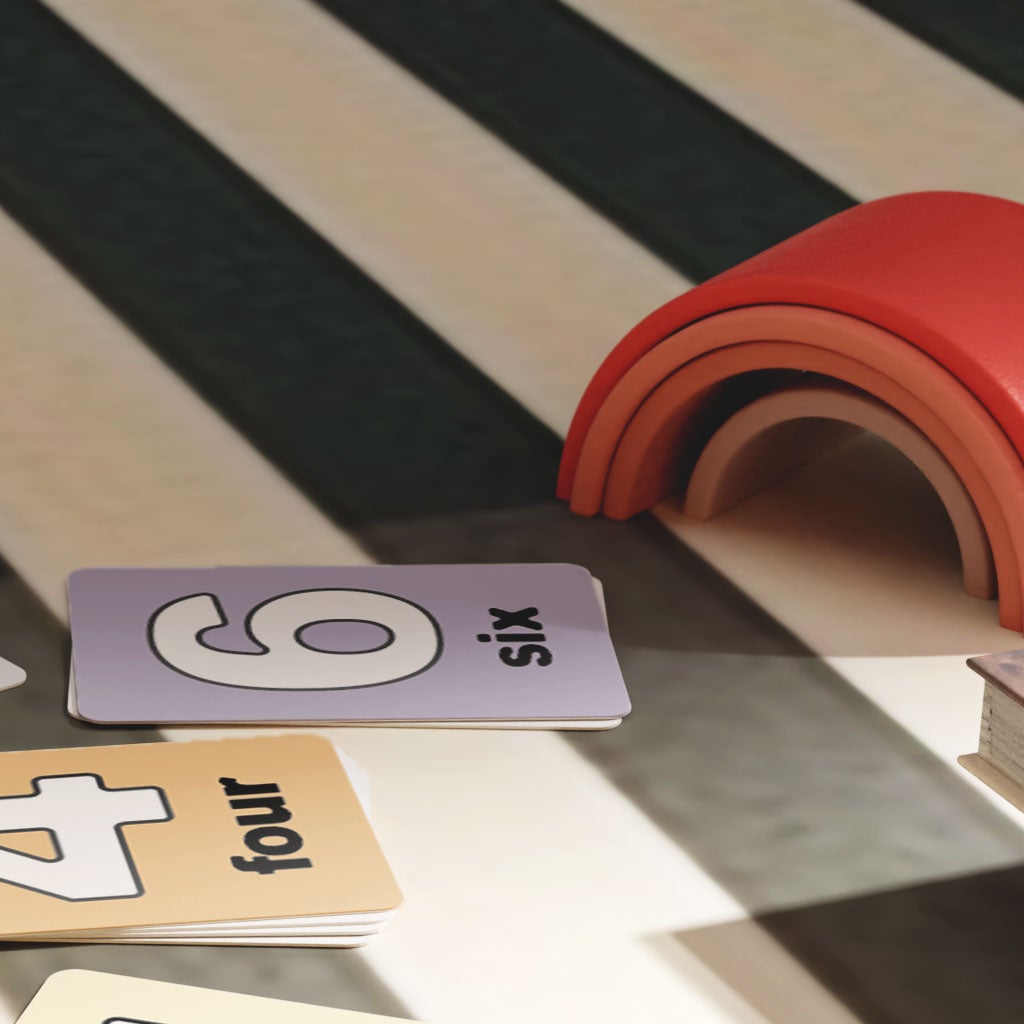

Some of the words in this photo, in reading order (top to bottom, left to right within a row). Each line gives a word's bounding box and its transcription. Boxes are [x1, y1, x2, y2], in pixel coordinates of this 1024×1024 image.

[146, 587, 445, 692] 6
[476, 606, 553, 667] six
[218, 776, 313, 876] four
